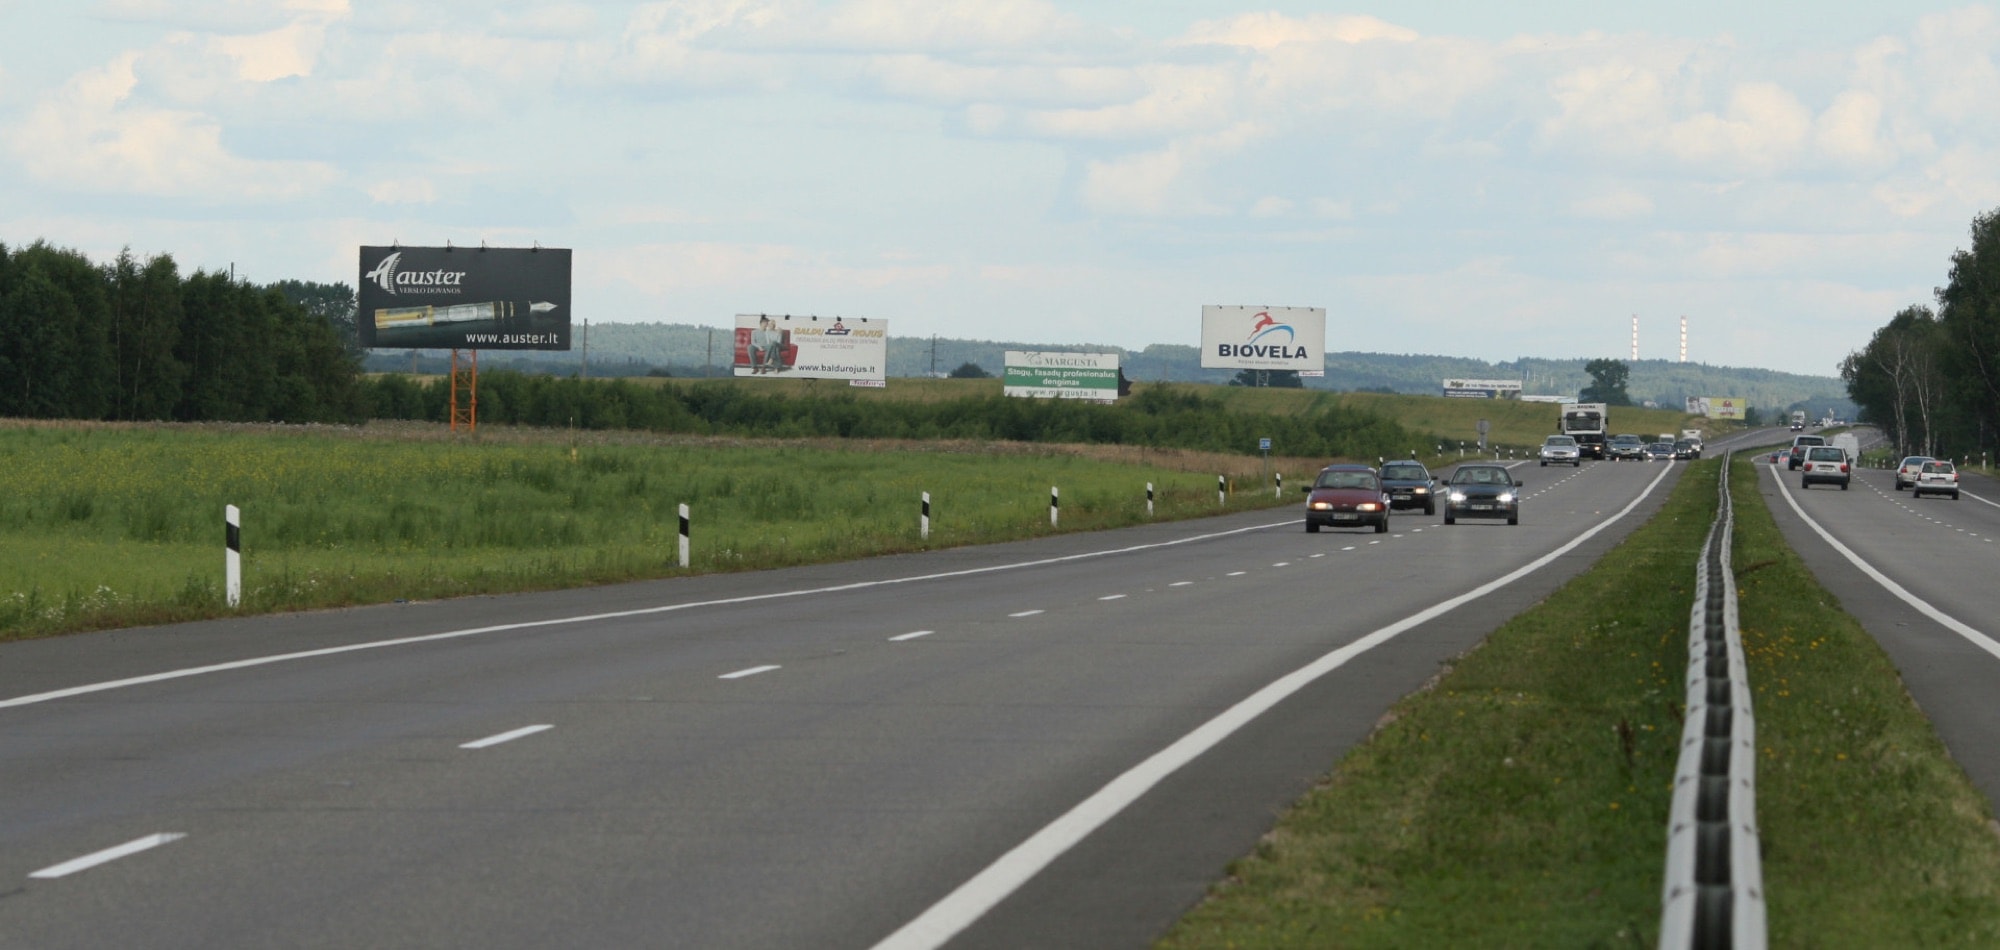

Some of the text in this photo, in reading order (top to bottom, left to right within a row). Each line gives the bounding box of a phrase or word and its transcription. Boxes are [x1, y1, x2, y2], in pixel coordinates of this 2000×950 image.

[396, 268, 466, 285] auster
[466, 332, 559, 345] www.auster.lt
[852, 329, 884, 338] ROJUS
[1218, 344, 1308, 359] BIOVELA
[1045, 358, 1098, 367] MARGUSTA
[798, 363, 876, 374] www.baldurojus.lt
[1063, 370, 1116, 379] profesionalus
[1042, 378, 1080, 387] dengimas
